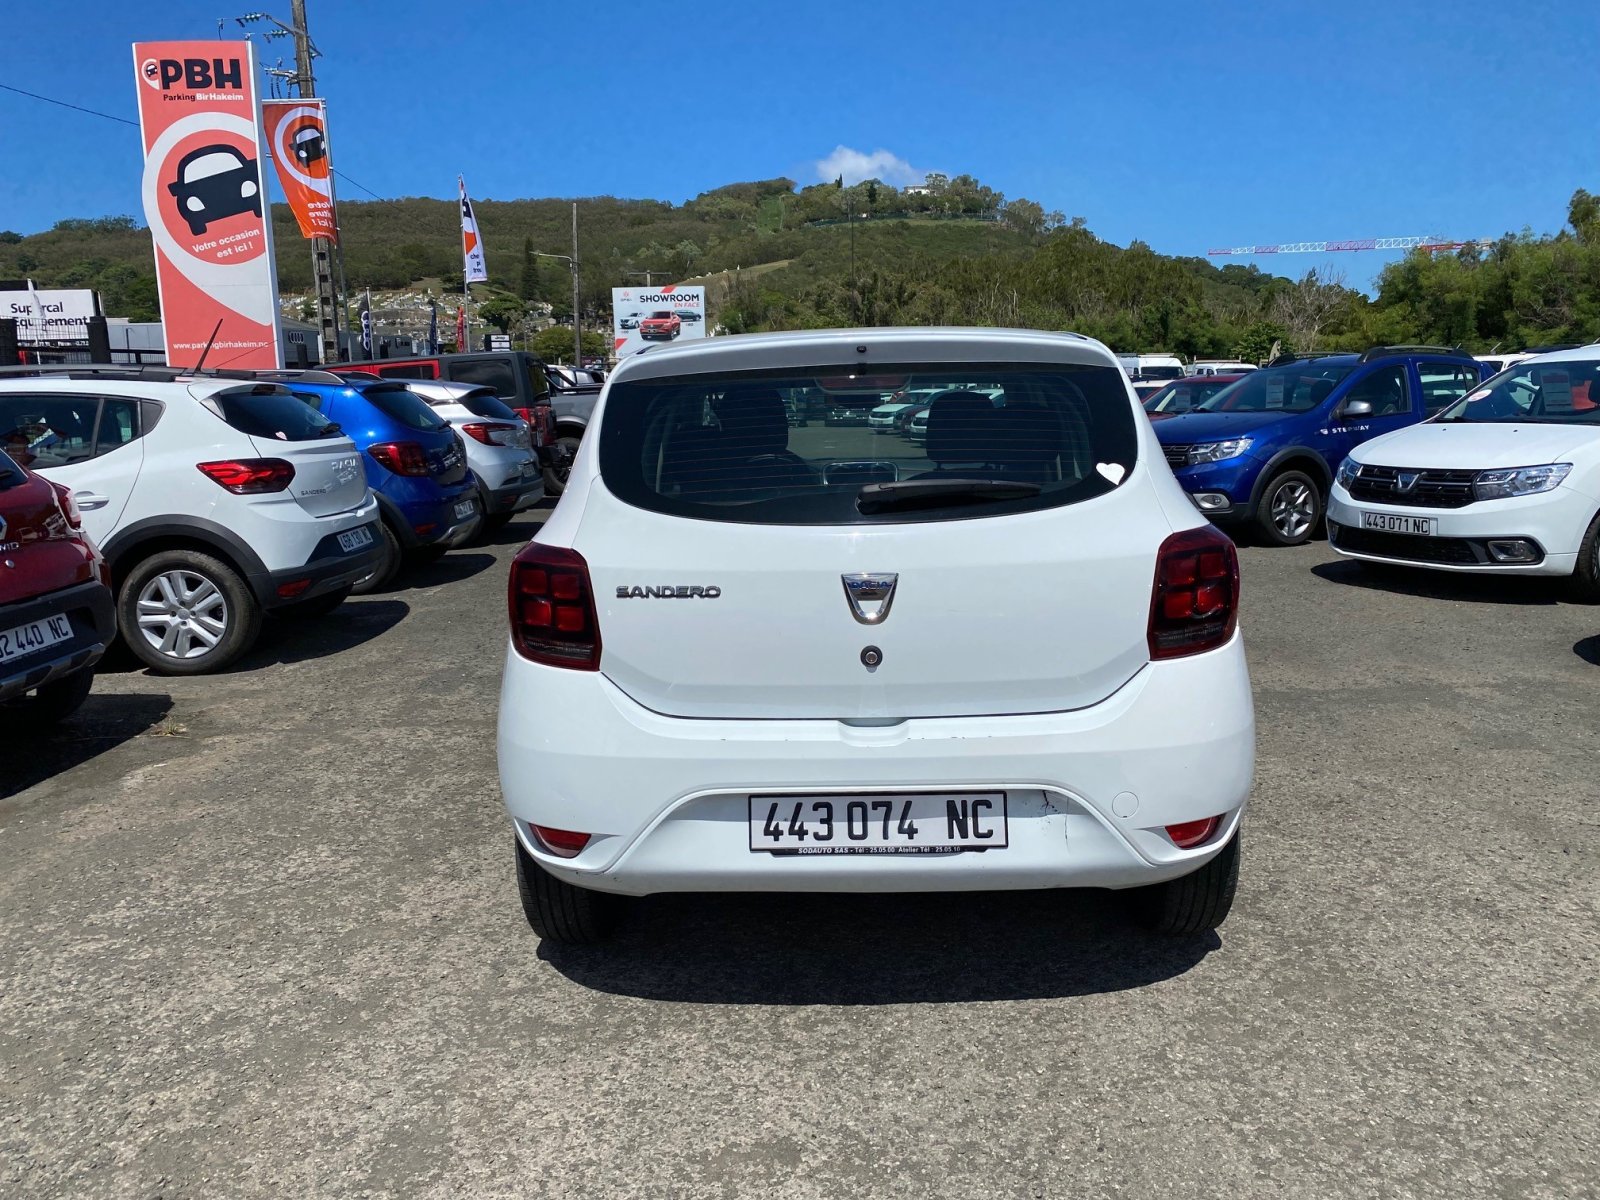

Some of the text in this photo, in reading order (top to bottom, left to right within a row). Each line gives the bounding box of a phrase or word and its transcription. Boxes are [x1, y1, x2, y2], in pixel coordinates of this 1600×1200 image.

[159, 58, 243, 90] PBH
[192, 228, 260, 253] Votre occasion
[216, 247, 233, 258] est
[234, 242, 248, 253] ici
[639, 293, 700, 303] SHOWROOM
[11, 302, 64, 316] Suprcal
[14, 316, 88, 332] Equpement
[1366, 514, 1428, 533] 443 071 NC
[616, 585, 722, 599] SANDERO
[0, 634, 14, 658] 2
[15, 624, 45, 650] 440
[47, 616, 69, 640] NC
[763, 799, 994, 842] 443 074 NC
